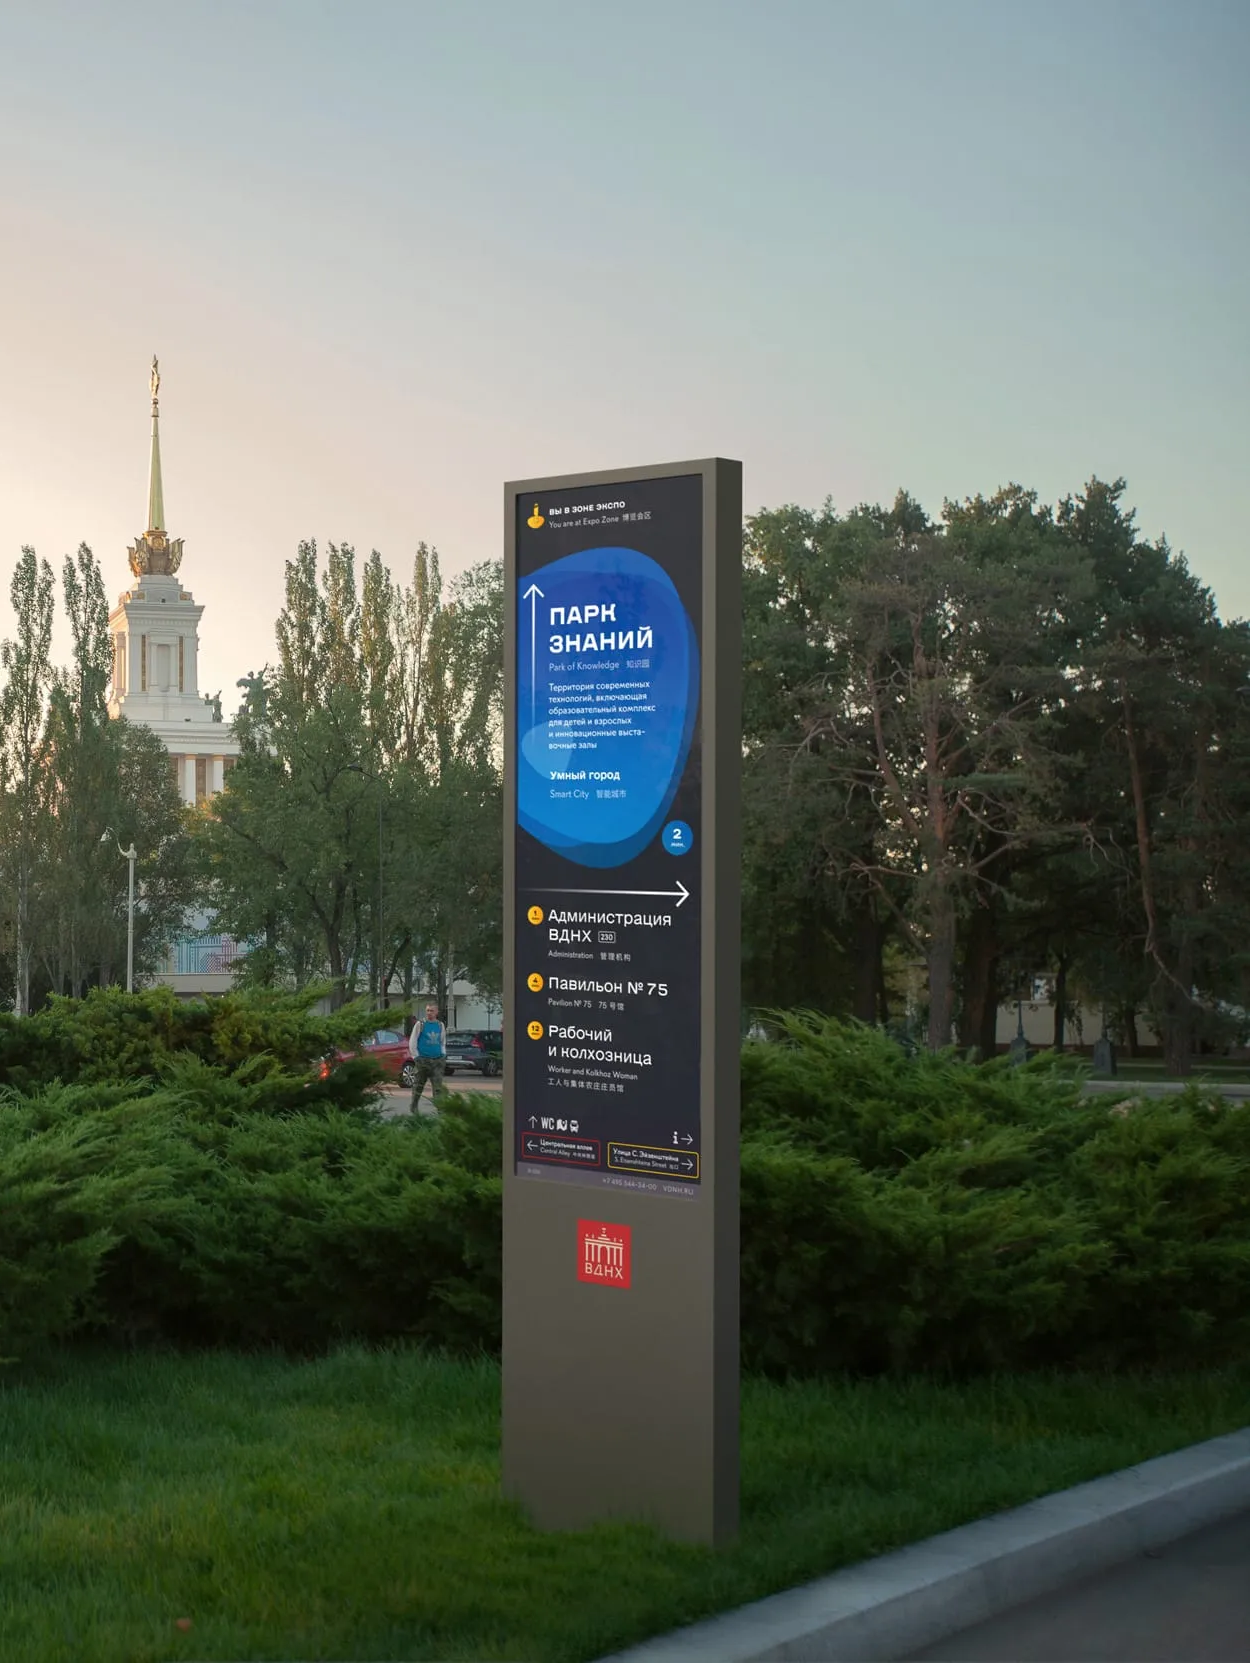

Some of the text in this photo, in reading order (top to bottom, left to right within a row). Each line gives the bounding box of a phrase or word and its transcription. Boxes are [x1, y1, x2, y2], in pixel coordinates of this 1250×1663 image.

[550, 508, 562, 516] ВЫ
[572, 504, 594, 513] ЗОНЕ
[596, 501, 626, 511] ЭКСПО
[583, 517, 600, 527] Expo
[602, 515, 619, 524] Zone
[550, 604, 617, 626] ПАРК
[550, 626, 653, 654] ЗНАНИЙ
[549, 660, 620, 672] Park of Knowledge
[549, 681, 650, 693] Территория современных
[549, 693, 647, 703] технологий, включающая
[548, 704, 656, 716] образовательный комплекс
[548, 719, 562, 728] для
[564, 718, 586, 727] детей
[594, 718, 632, 727] взрослых
[555, 730, 617, 738] инновационные
[550, 770, 621, 782] Умный город
[550, 789, 590, 800] Smart City
[672, 828, 682, 840] 2
[548, 909, 672, 928] Администрация
[549, 929, 592, 944] ВДНХ
[600, 933, 614, 941] 230
[548, 950, 594, 960] Administration
[549, 977, 668, 996] Павильон № 75
[548, 998, 573, 1008] Pavilion
[583, 1000, 592, 1009] 75
[549, 1024, 612, 1042] Рабочий
[548, 1046, 652, 1066] и колхозница
[548, 1064, 571, 1074] Worker
[586, 1069, 611, 1078] Kolkhoz
[612, 1071, 638, 1080] Woman
[540, 1117, 555, 1131] WC
[613, 1147, 631, 1157] Улица
[585, 1262, 624, 1280] ВДНХ
